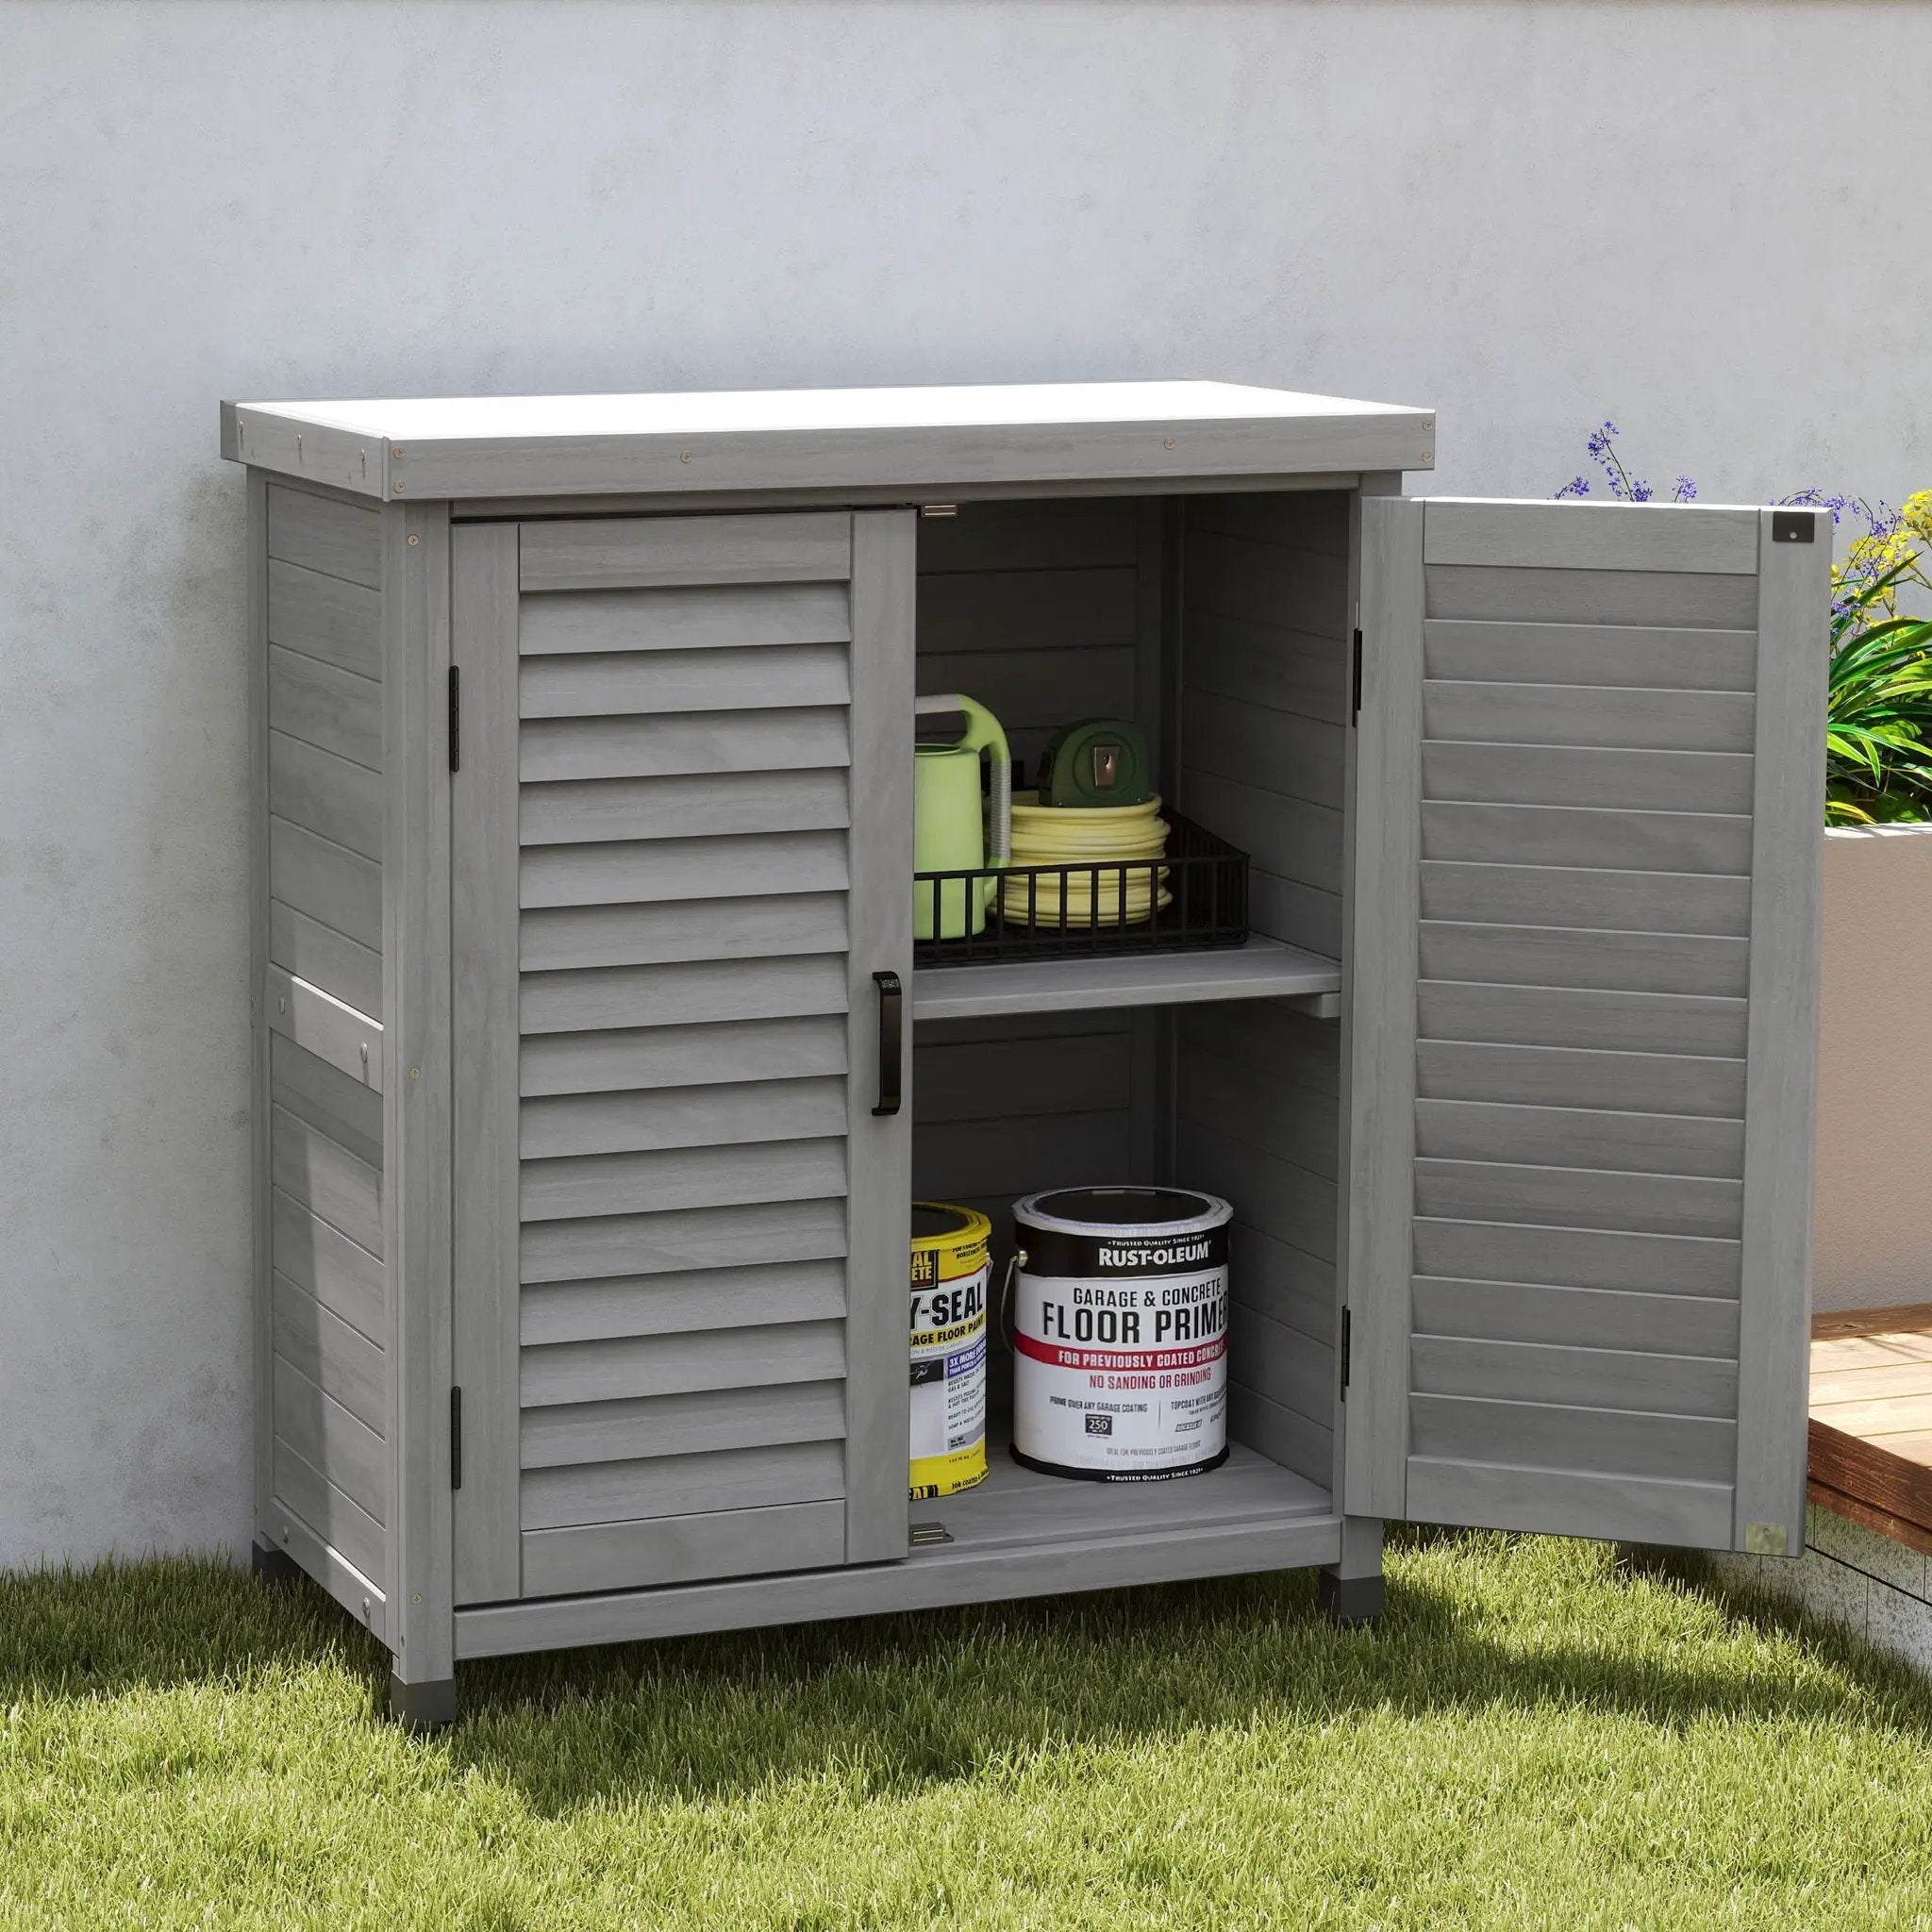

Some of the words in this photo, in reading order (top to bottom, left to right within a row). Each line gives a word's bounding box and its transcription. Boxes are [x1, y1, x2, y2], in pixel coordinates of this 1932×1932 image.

[1099, 1241, 1208, 1267] RUST-OLEUM
[1074, 1287, 1138, 1308] GARAGE
[1143, 1291, 1156, 1307] &
[1162, 1277, 1220, 1306] CONCRETE
[938, 1325, 965, 1341] FLOOR
[968, 1313, 984, 1333] PAINT
[1042, 1301, 1140, 1343] FLOOR
[949, 1357, 958, 1368] 3X
[959, 1350, 975, 1364] MORE
[1058, 1350, 1080, 1365] FOR
[1083, 1353, 1153, 1368] PREVIOUSLY
[1158, 1351, 1194, 1366] COATED
[949, 1365, 960, 1375] THAN
[1090, 1374, 1104, 1388] NO
[1108, 1374, 1156, 1390] SANDING
[1159, 1374, 1171, 1388] OR
[1174, 1367, 1211, 1387] GRINDING
[1068, 1399, 1083, 1409] OVER
[1084, 1402, 1095, 1410] ANY
[1096, 1402, 1120, 1412] GARAGE
[1122, 1403, 1147, 1412] COATING
[1171, 1398, 1194, 1410] TOPCOAT
[1089, 1419, 1108, 1430] 250
[1171, 1471, 1189, 1479] SINCE
